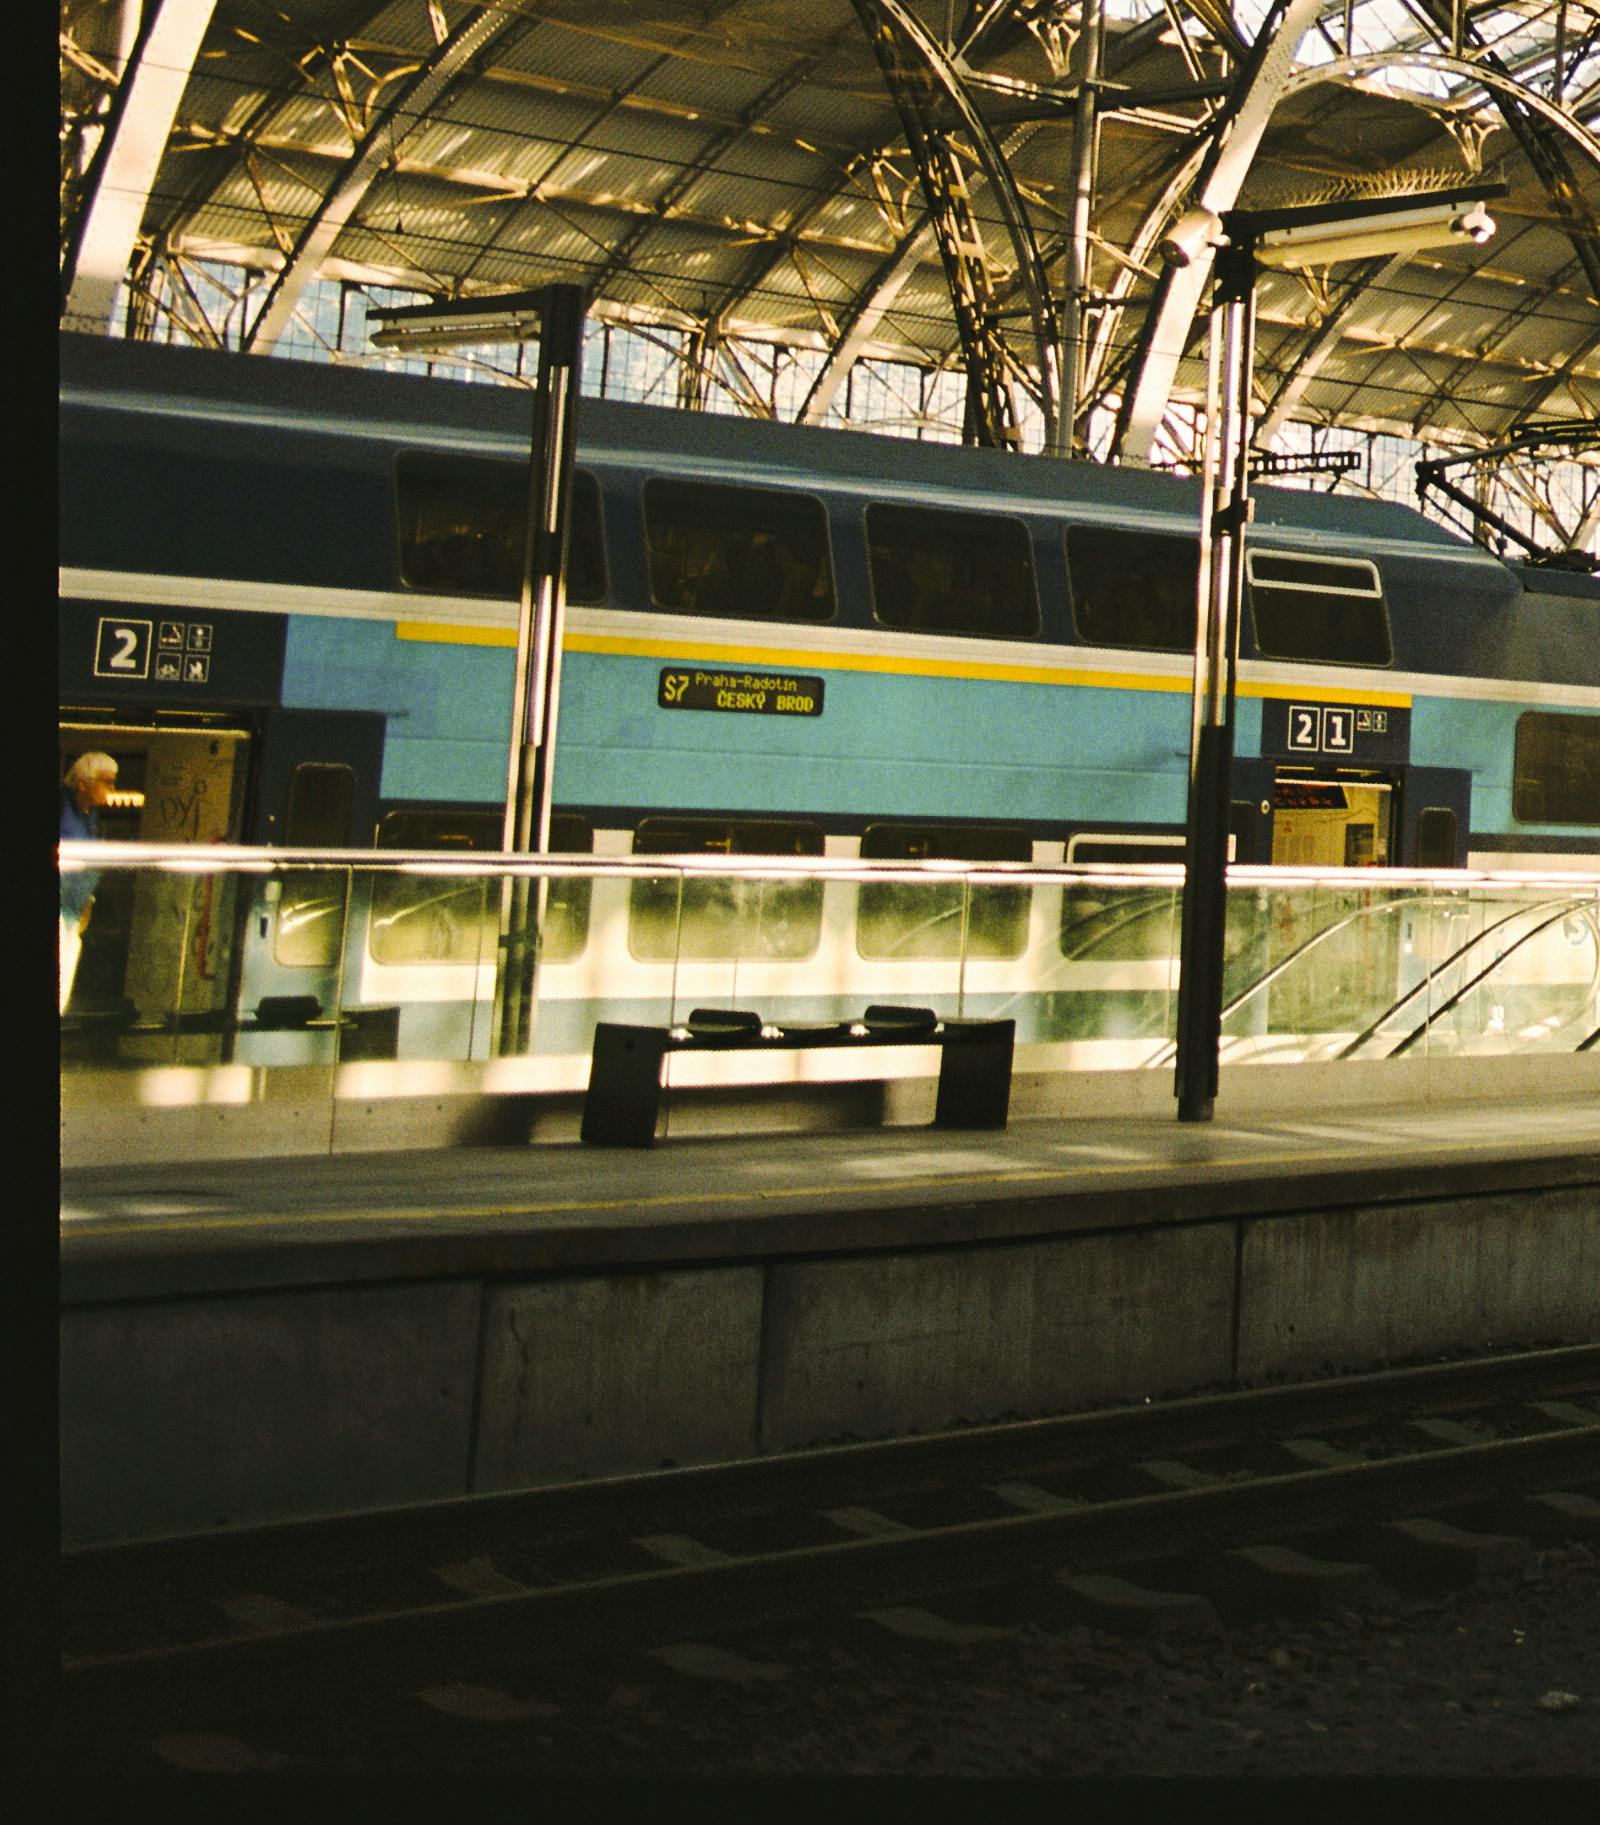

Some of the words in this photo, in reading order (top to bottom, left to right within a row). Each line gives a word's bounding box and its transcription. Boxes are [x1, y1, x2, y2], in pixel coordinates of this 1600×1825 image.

[110, 628, 138, 668] 2
[664, 675, 689, 702] S7
[776, 694, 814, 713] BROD
[1296, 713, 1313, 744] 2
[1330, 715, 1347, 746] 1
